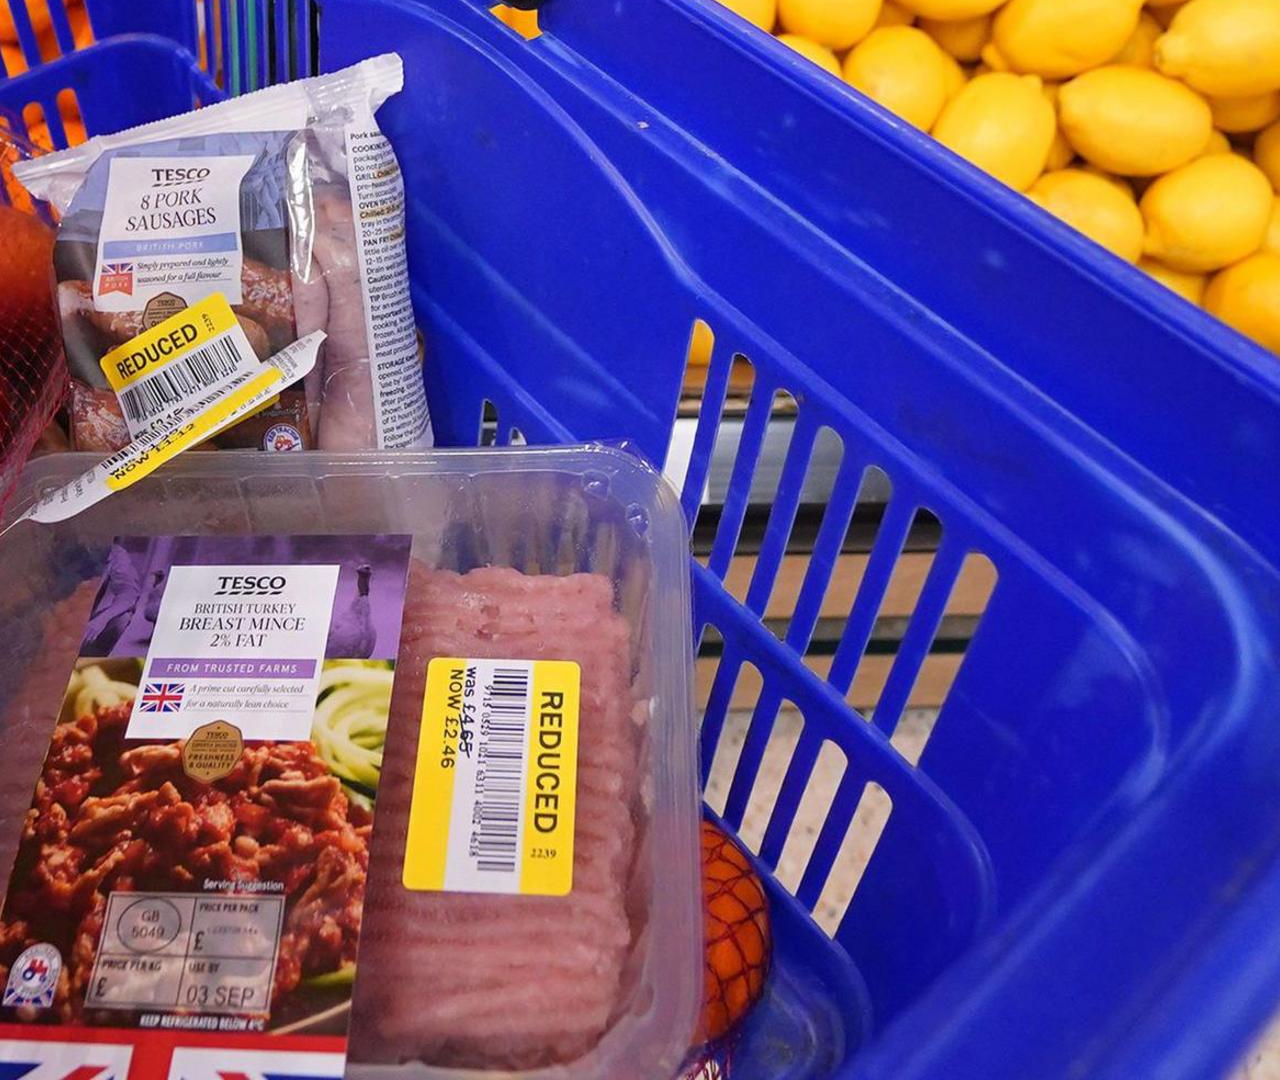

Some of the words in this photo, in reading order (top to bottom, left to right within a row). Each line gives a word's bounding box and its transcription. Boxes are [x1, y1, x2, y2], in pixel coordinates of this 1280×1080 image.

[350, 131, 368, 140] Pork
[152, 168, 210, 182] TESCO
[140, 195, 150, 210] 8
[155, 188, 202, 209] PORK
[359, 200, 379, 210] OVEN
[125, 207, 217, 231] SAUSAGES
[136, 242, 175, 253] BRITISH
[177, 240, 205, 251] PORK
[363, 238, 378, 247] PAN
[137, 261, 158, 271] Simply
[159, 259, 191, 270] prepared
[207, 257, 229, 267] lightly
[137, 274, 166, 283] seasoned
[183, 270, 196, 282] full
[196, 270, 222, 281] flavour
[368, 274, 393, 284] Caution
[117, 324, 198, 380] REDUCED
[377, 357, 405, 371] STORAGE
[115, 454, 150, 480] NOW
[218, 576, 287, 590] TESCO
[194, 603, 242, 614] BRITISH
[245, 603, 297, 614] TURKEY
[179, 617, 246, 631] BREAST
[248, 617, 306, 631] MINCE
[210, 634, 231, 647] 2%
[235, 634, 268, 647] FAT
[167, 663, 200, 673] FROM
[204, 663, 255, 674] TRUSTED
[259, 663, 297, 674] FARMS
[464, 667, 477, 698] was
[189, 684, 196, 693] A
[197, 684, 223, 696] prime
[224, 684, 237, 693] cut
[238, 683, 270, 696] carefully
[272, 684, 304, 694] selected
[448, 669, 464, 710] NOW
[185, 699, 198, 710] for
[206, 699, 242, 710] naturally
[243, 699, 262, 708] lean
[263, 699, 289, 709] choice
[206, 731, 229, 740] TESCO
[440, 717, 459, 769] £2.46
[188, 753, 235, 762] FRESHNESS
[533, 692, 564, 834] REDUCED
[195, 762, 231, 770] QUALITY
[203, 878, 235, 890] Serving
[237, 879, 284, 891] Suggestion
[200, 903, 221, 913] PRICE
[223, 904, 237, 913] PER
[239, 904, 259, 913] PACK
[141, 911, 160, 921] GB
[194, 931, 205, 951] £
[102, 960, 127, 970] PRICE
[129, 960, 147, 970] PER
[189, 962, 206, 971] USE
[207, 963, 220, 971] BY
[96, 977, 107, 997] £
[186, 986, 209, 1004] 03
[216, 987, 255, 1007] SEP
[140, 1014, 160, 1027] KEEP
[161, 1015, 219, 1029] REFRIGERATED
[219, 1017, 247, 1031] BELOW
